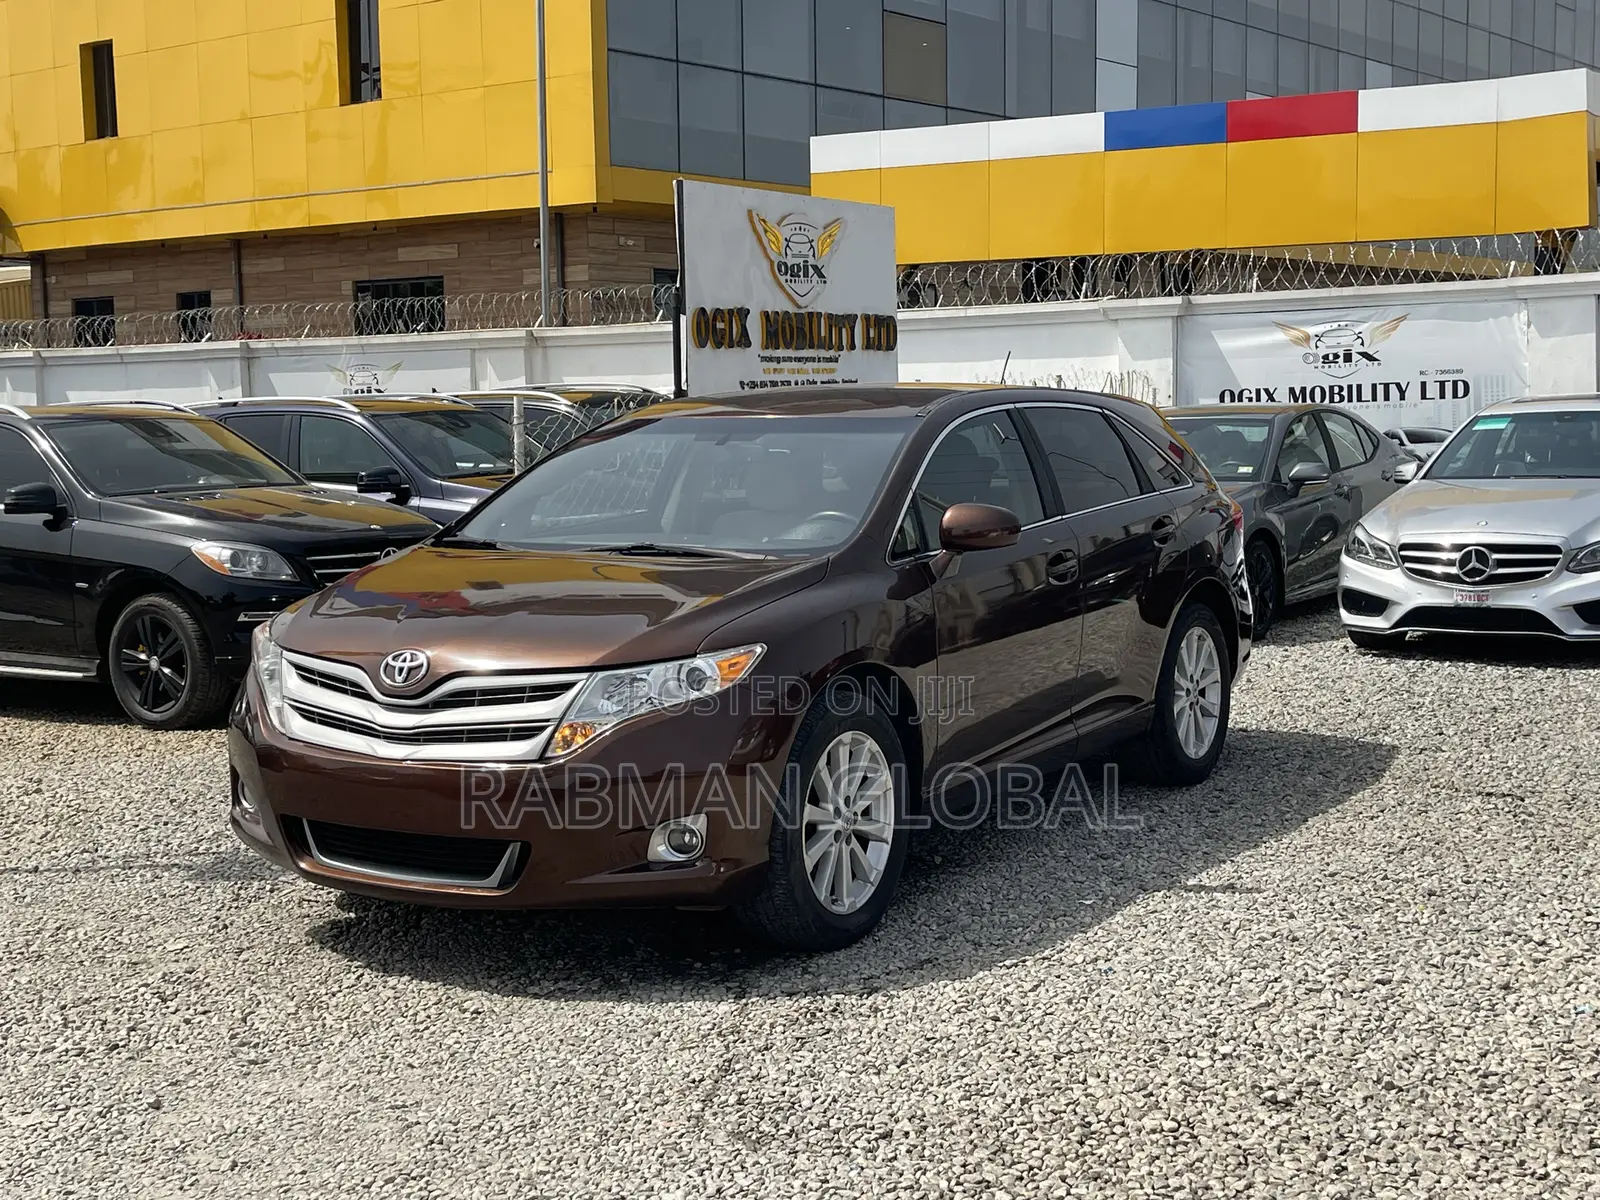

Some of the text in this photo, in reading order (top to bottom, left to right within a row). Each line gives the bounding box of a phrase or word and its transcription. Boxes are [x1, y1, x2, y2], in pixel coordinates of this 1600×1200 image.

[691, 306, 898, 351] OGIX MOBILITY LTD
[1218, 379, 1471, 404] OGIX MOBILITY LTD
